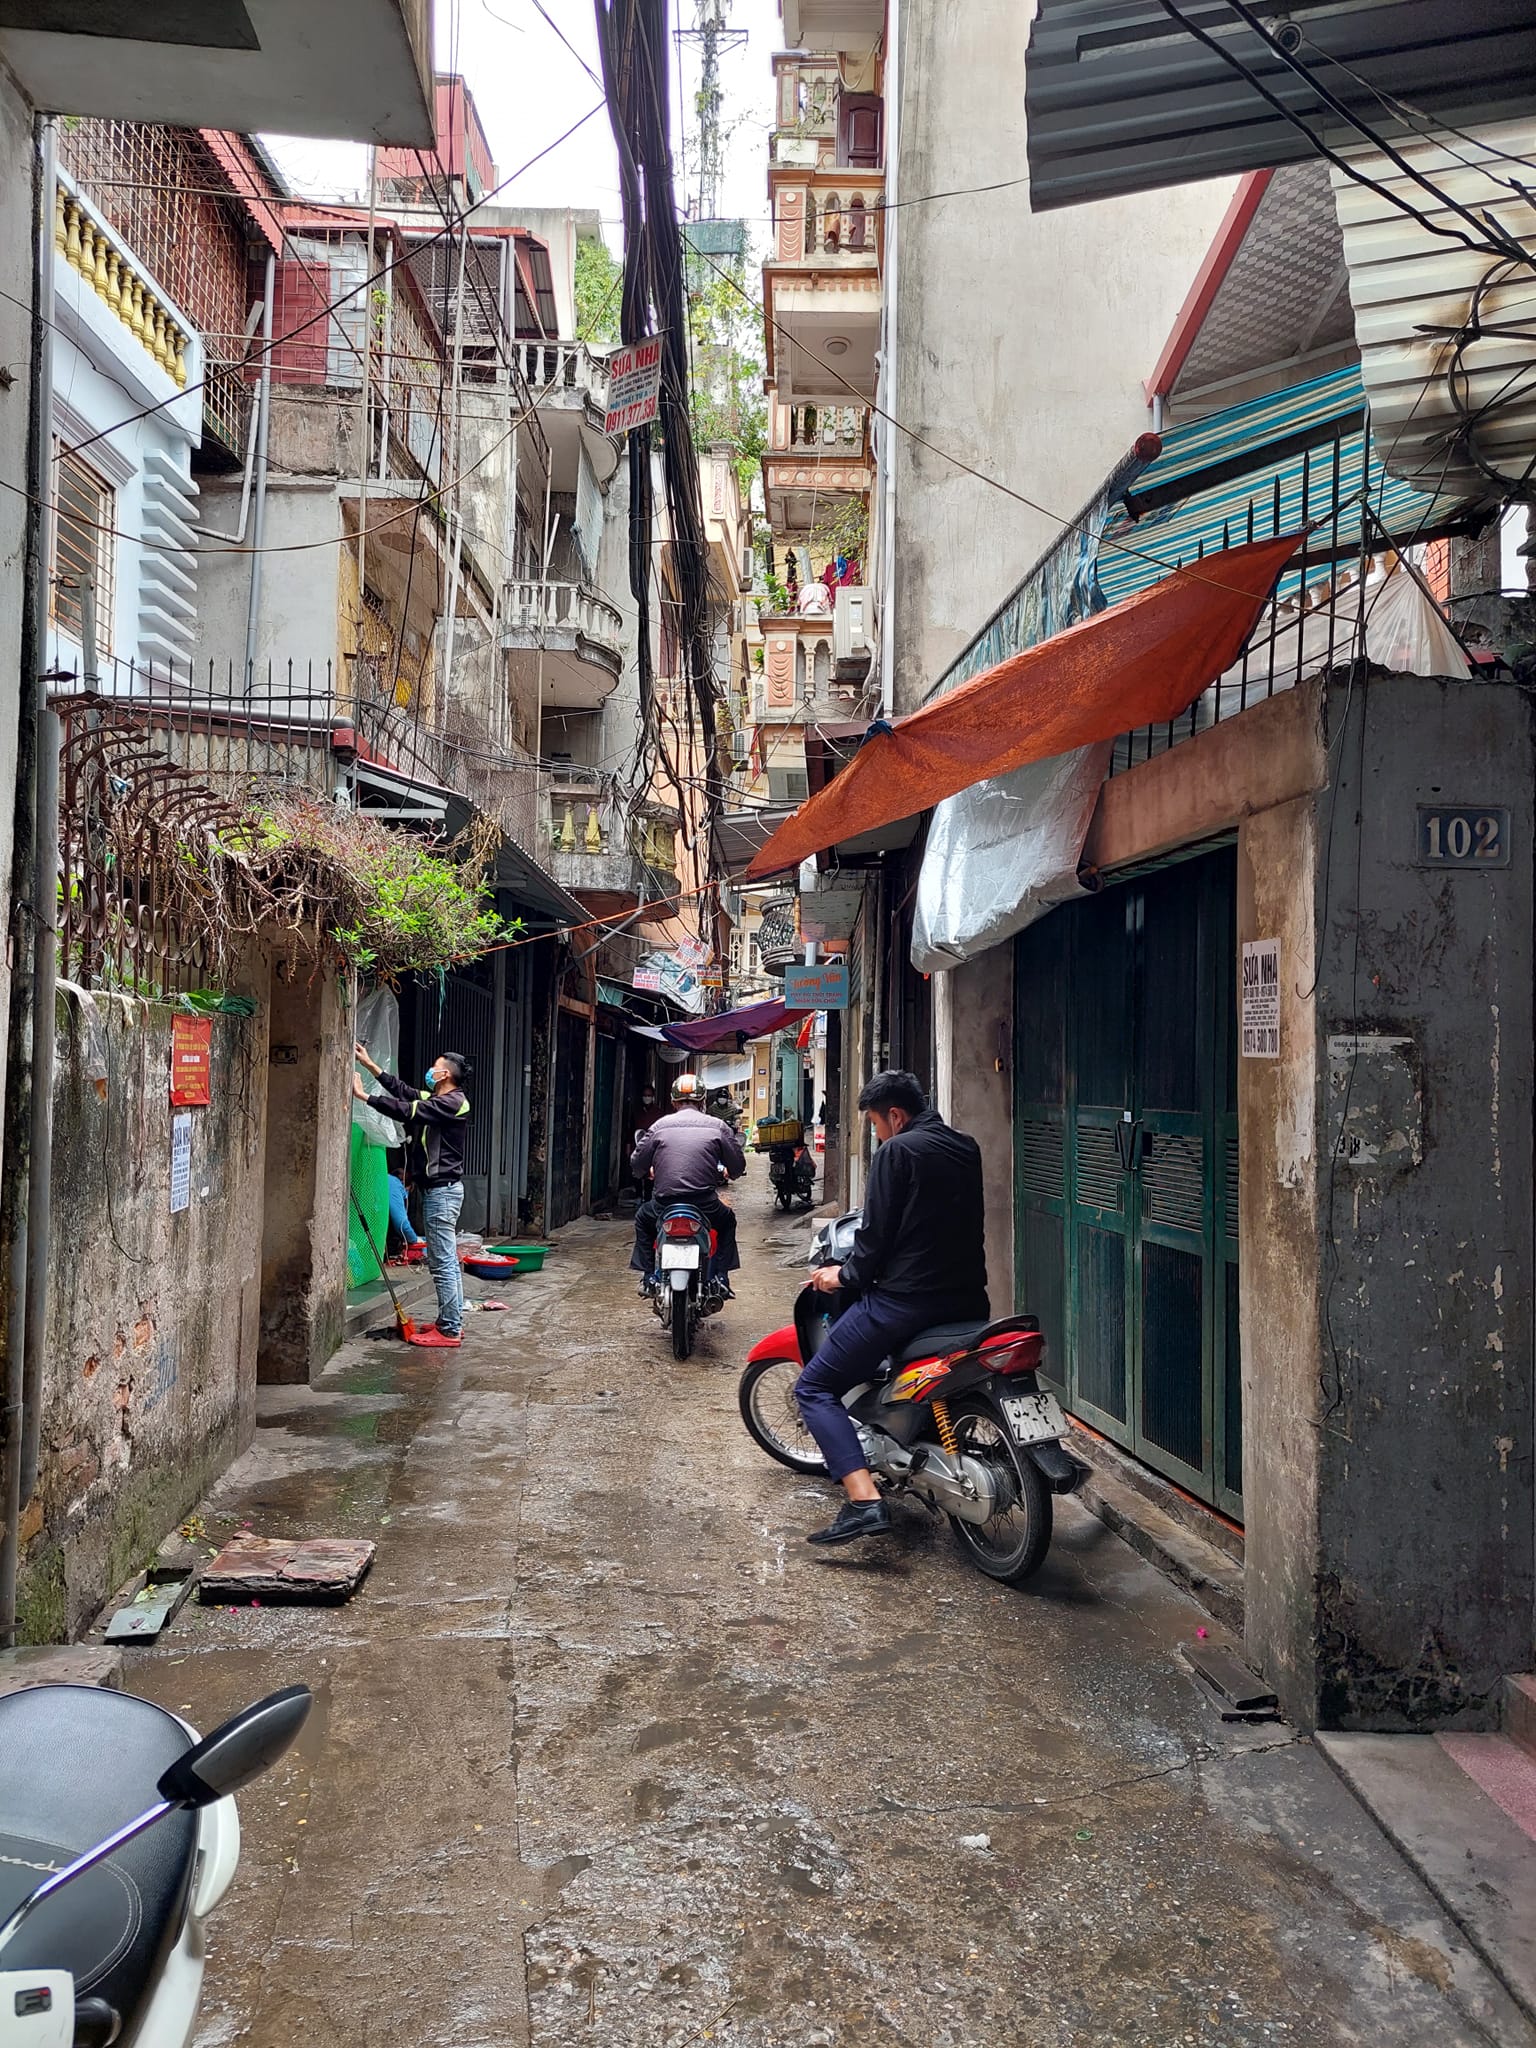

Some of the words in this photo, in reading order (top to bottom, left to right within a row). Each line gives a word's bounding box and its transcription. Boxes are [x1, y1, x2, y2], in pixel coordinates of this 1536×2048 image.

[635, 339, 660, 369] NHÀ
[1426, 816, 1502, 858] 102
[1243, 943, 1259, 987] SỬA
[1261, 946, 1278, 985] NHÀ
